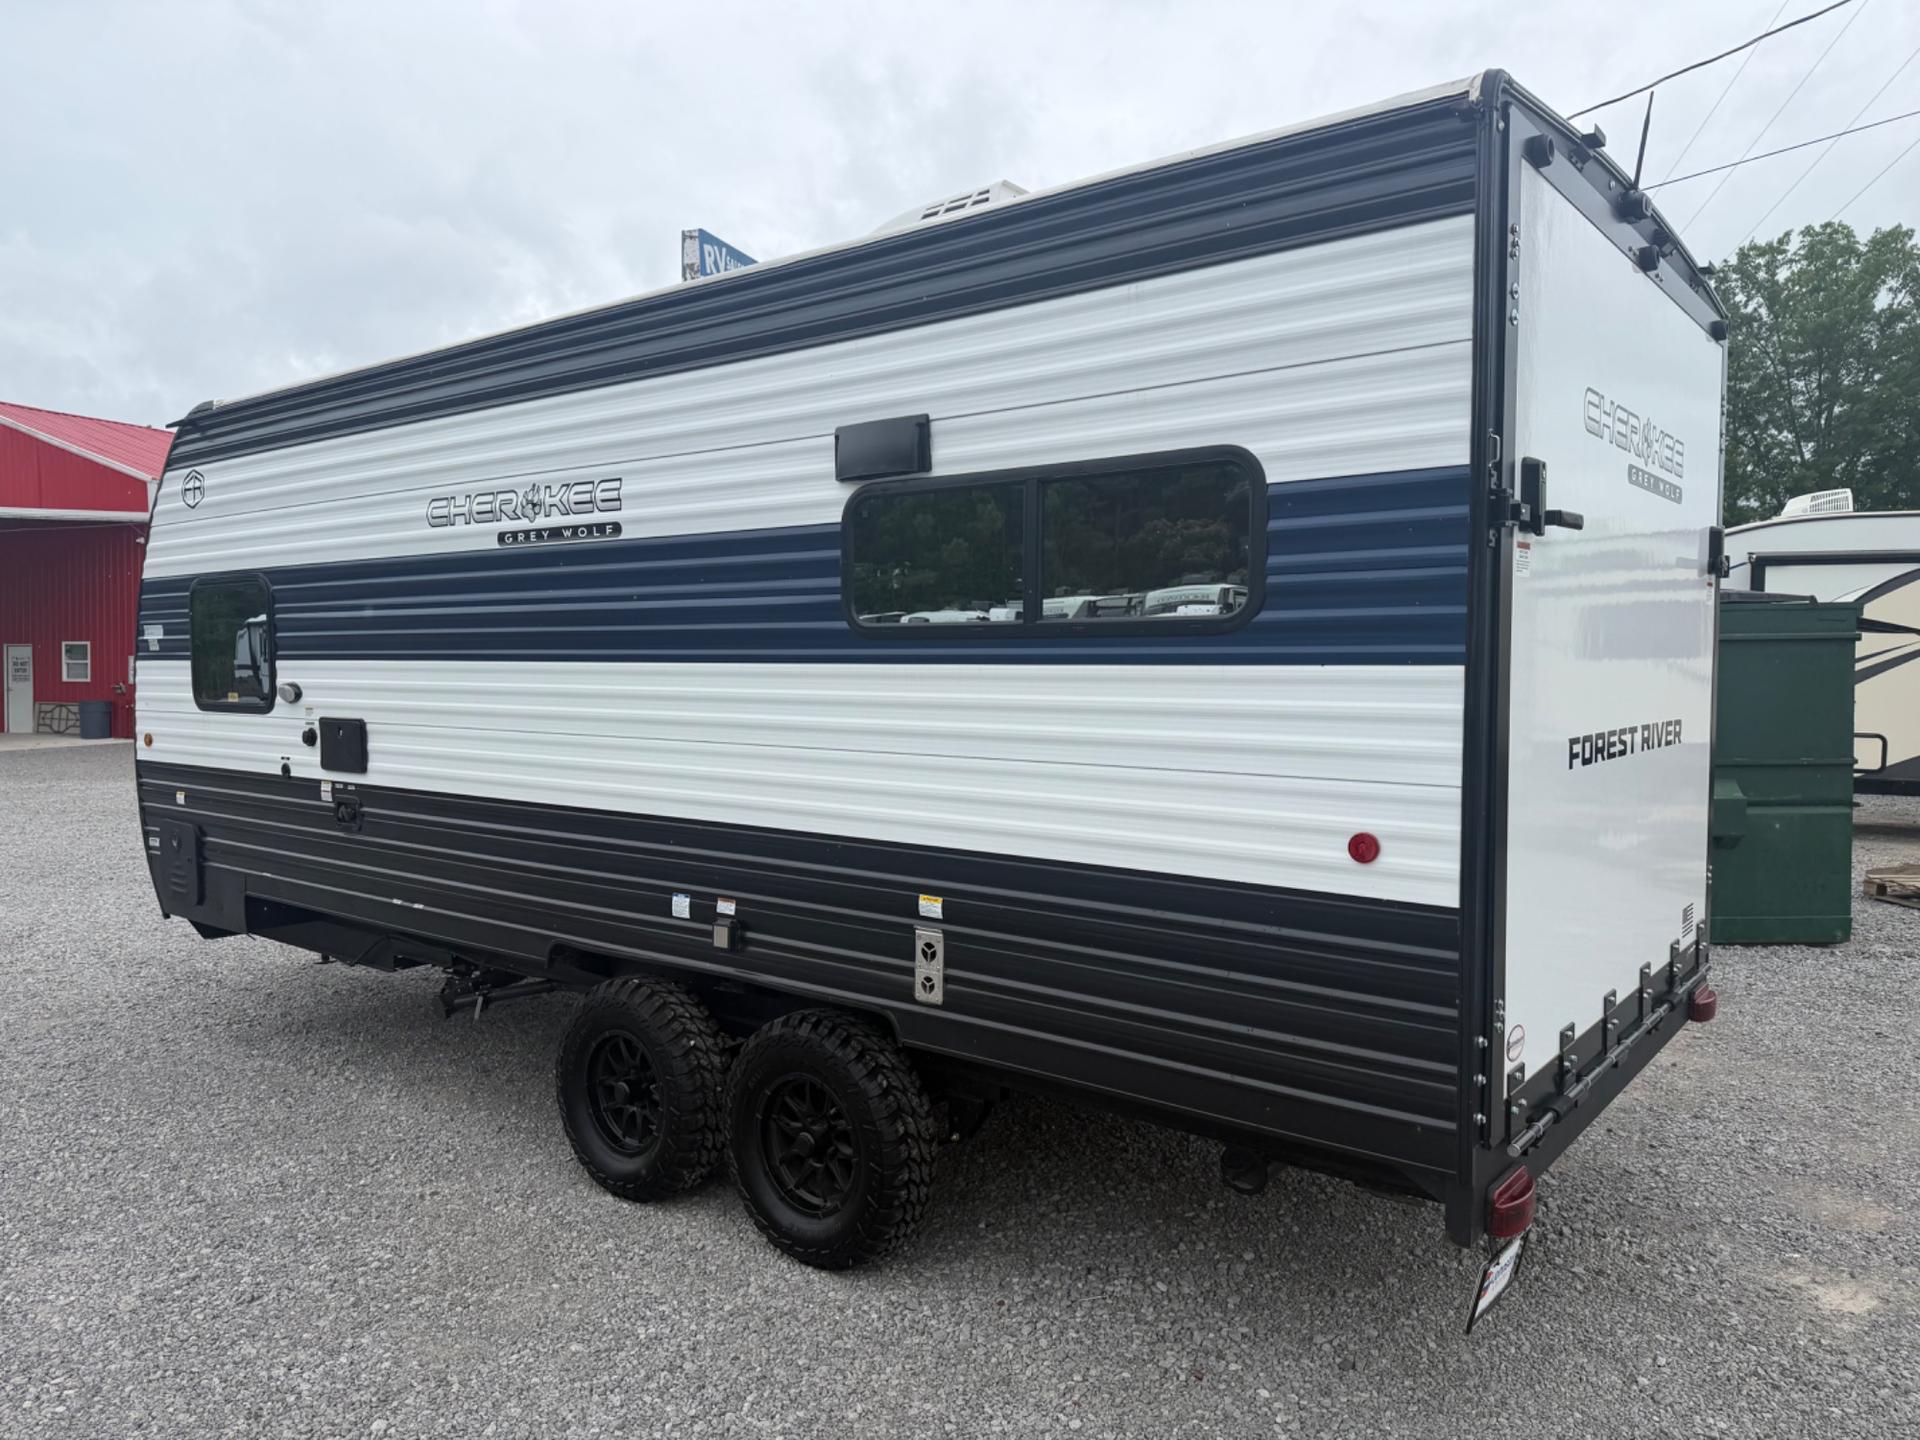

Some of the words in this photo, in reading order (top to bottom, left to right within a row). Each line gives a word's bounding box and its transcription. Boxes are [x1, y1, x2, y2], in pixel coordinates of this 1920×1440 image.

[703, 243, 726, 274] RV
[504, 530, 550, 544] GREY
[562, 524, 614, 539] WOLF
[1568, 725, 1638, 770] FOREST
[1640, 718, 1683, 752] RIVER
